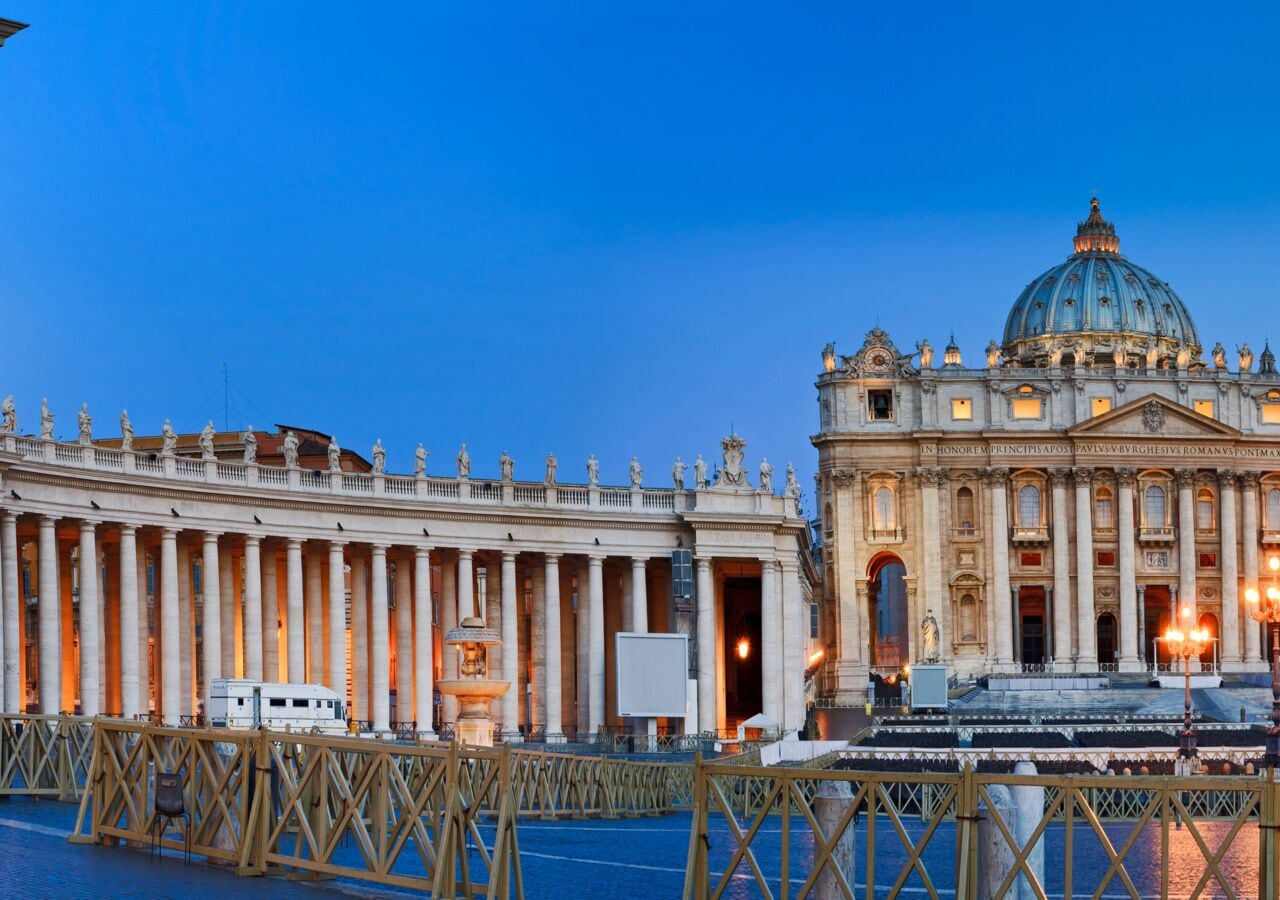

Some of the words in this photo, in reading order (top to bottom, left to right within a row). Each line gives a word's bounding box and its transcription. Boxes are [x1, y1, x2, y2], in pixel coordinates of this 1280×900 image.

[921, 444, 933, 454] IN
[936, 445, 989, 455] HONOREM
[991, 444, 1042, 454] PRINCIPIS
[1076, 444, 1109, 453] PAVLVS
[1119, 445, 1181, 454] BVRGHESIVS
[1183, 446, 1234, 456] ROMANVS
